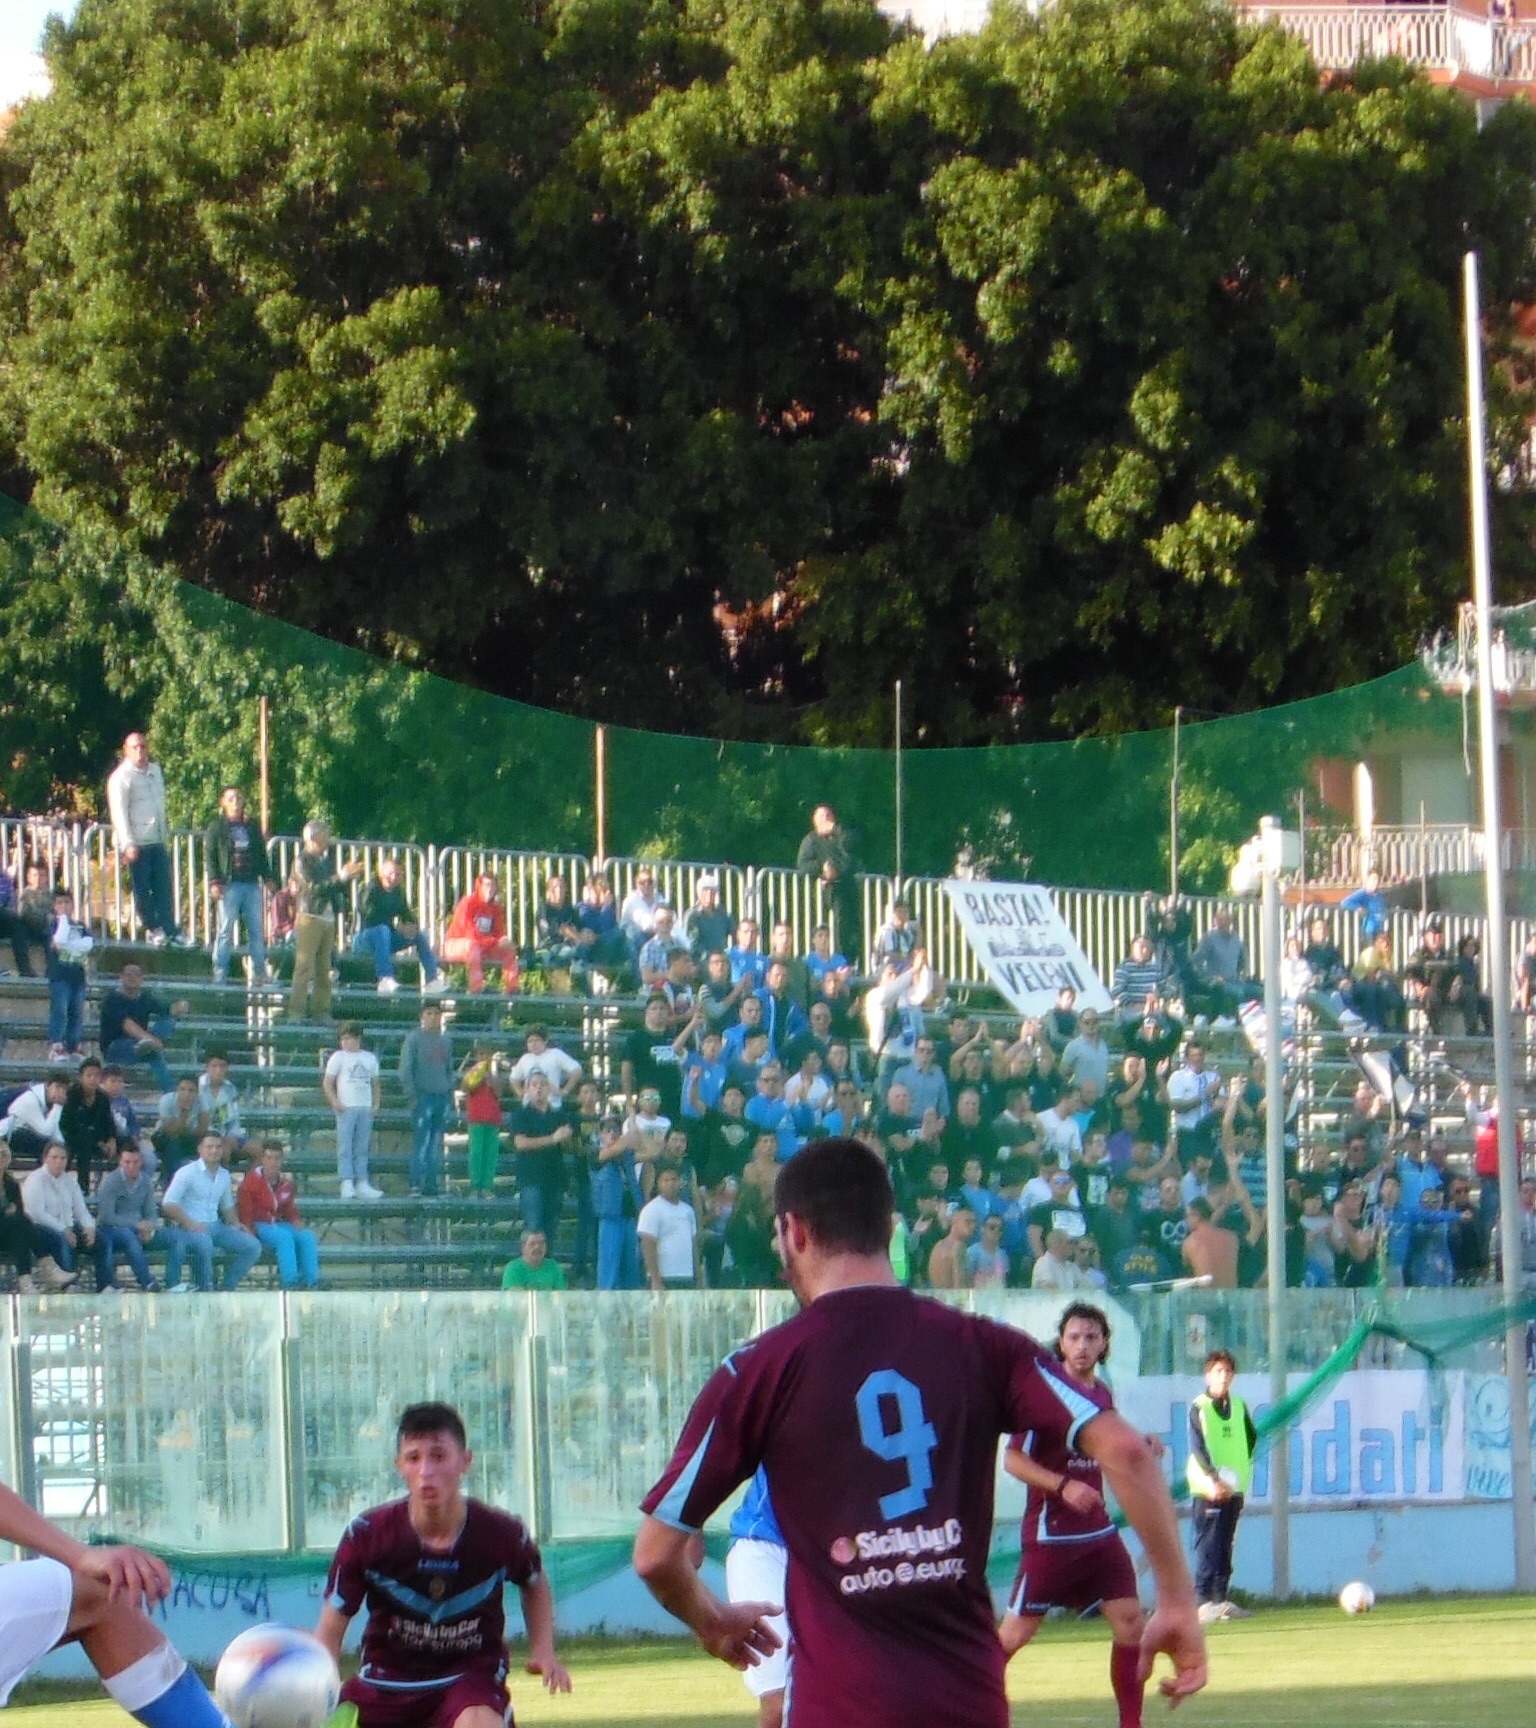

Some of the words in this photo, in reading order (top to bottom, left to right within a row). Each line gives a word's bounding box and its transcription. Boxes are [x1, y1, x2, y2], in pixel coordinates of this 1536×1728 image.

[963, 891, 1050, 926] BASTA!
[854, 1368, 939, 1521] 9
[840, 1566, 894, 1595] auto
